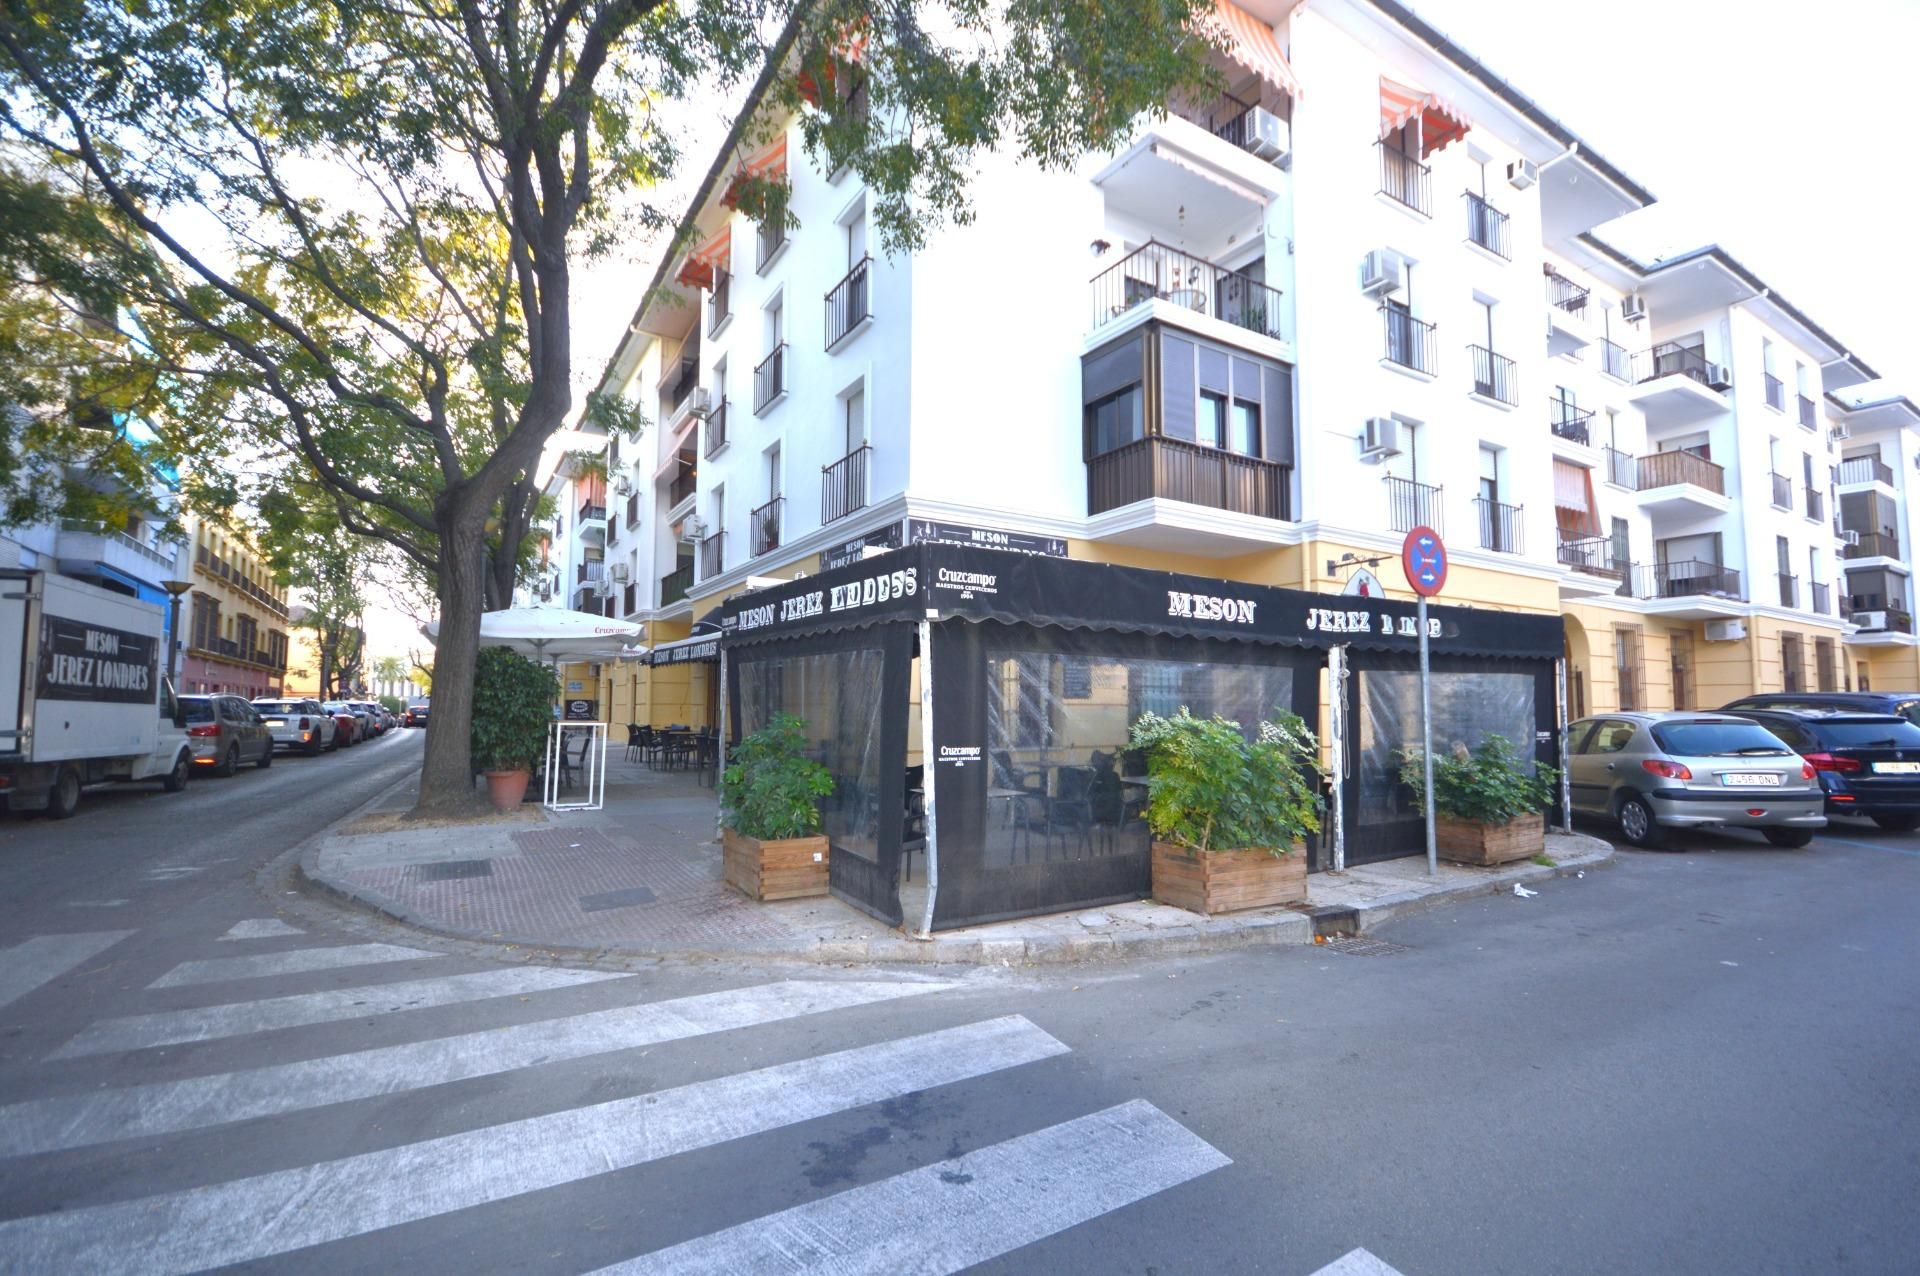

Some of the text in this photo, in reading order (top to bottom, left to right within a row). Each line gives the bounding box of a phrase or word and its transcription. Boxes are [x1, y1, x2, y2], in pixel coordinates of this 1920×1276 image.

[971, 530, 1009, 545] MESON
[938, 567, 997, 587] Cruzcampo
[738, 603, 775, 631] MESON
[780, 591, 824, 622] JEREZ
[1167, 590, 1258, 624] MESON
[1306, 608, 1371, 633] JEREZ
[85, 629, 119, 656] MESON
[47, 653, 149, 691] JEREZ LONDRES
[940, 745, 981, 757] Cruzcampo
